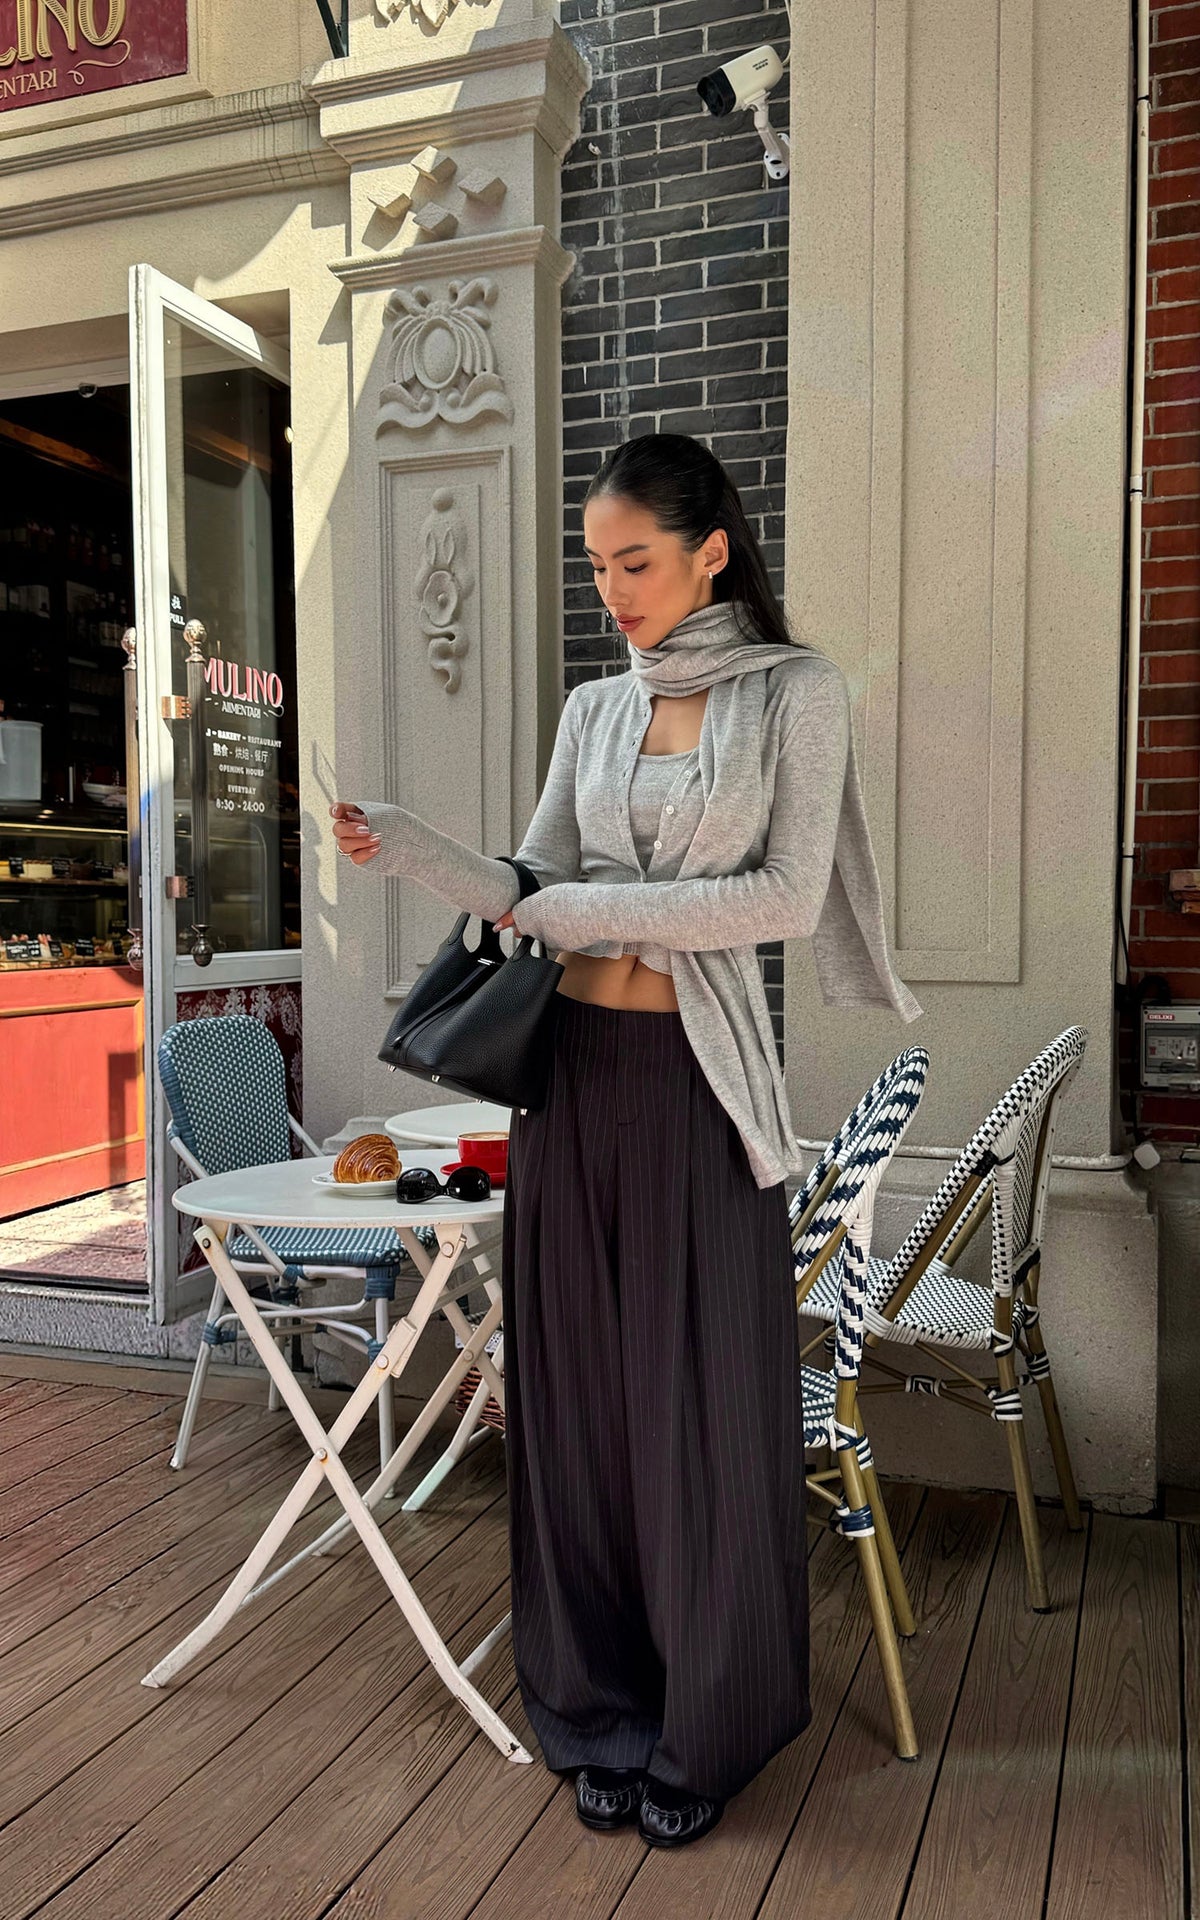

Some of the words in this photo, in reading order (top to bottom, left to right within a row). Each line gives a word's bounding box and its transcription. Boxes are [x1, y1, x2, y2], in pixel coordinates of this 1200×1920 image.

[0, 0, 126, 66] INO
[204, 656, 283, 708] MULINO
[217, 729, 242, 741] BAKERY
[247, 735, 282, 749] RESTAURANT
[218, 764, 244, 775] OPENING
[245, 767, 264, 777] HOURS
[227, 784, 256, 795] EVERYDAY
[215, 798, 235, 812] 8:30
